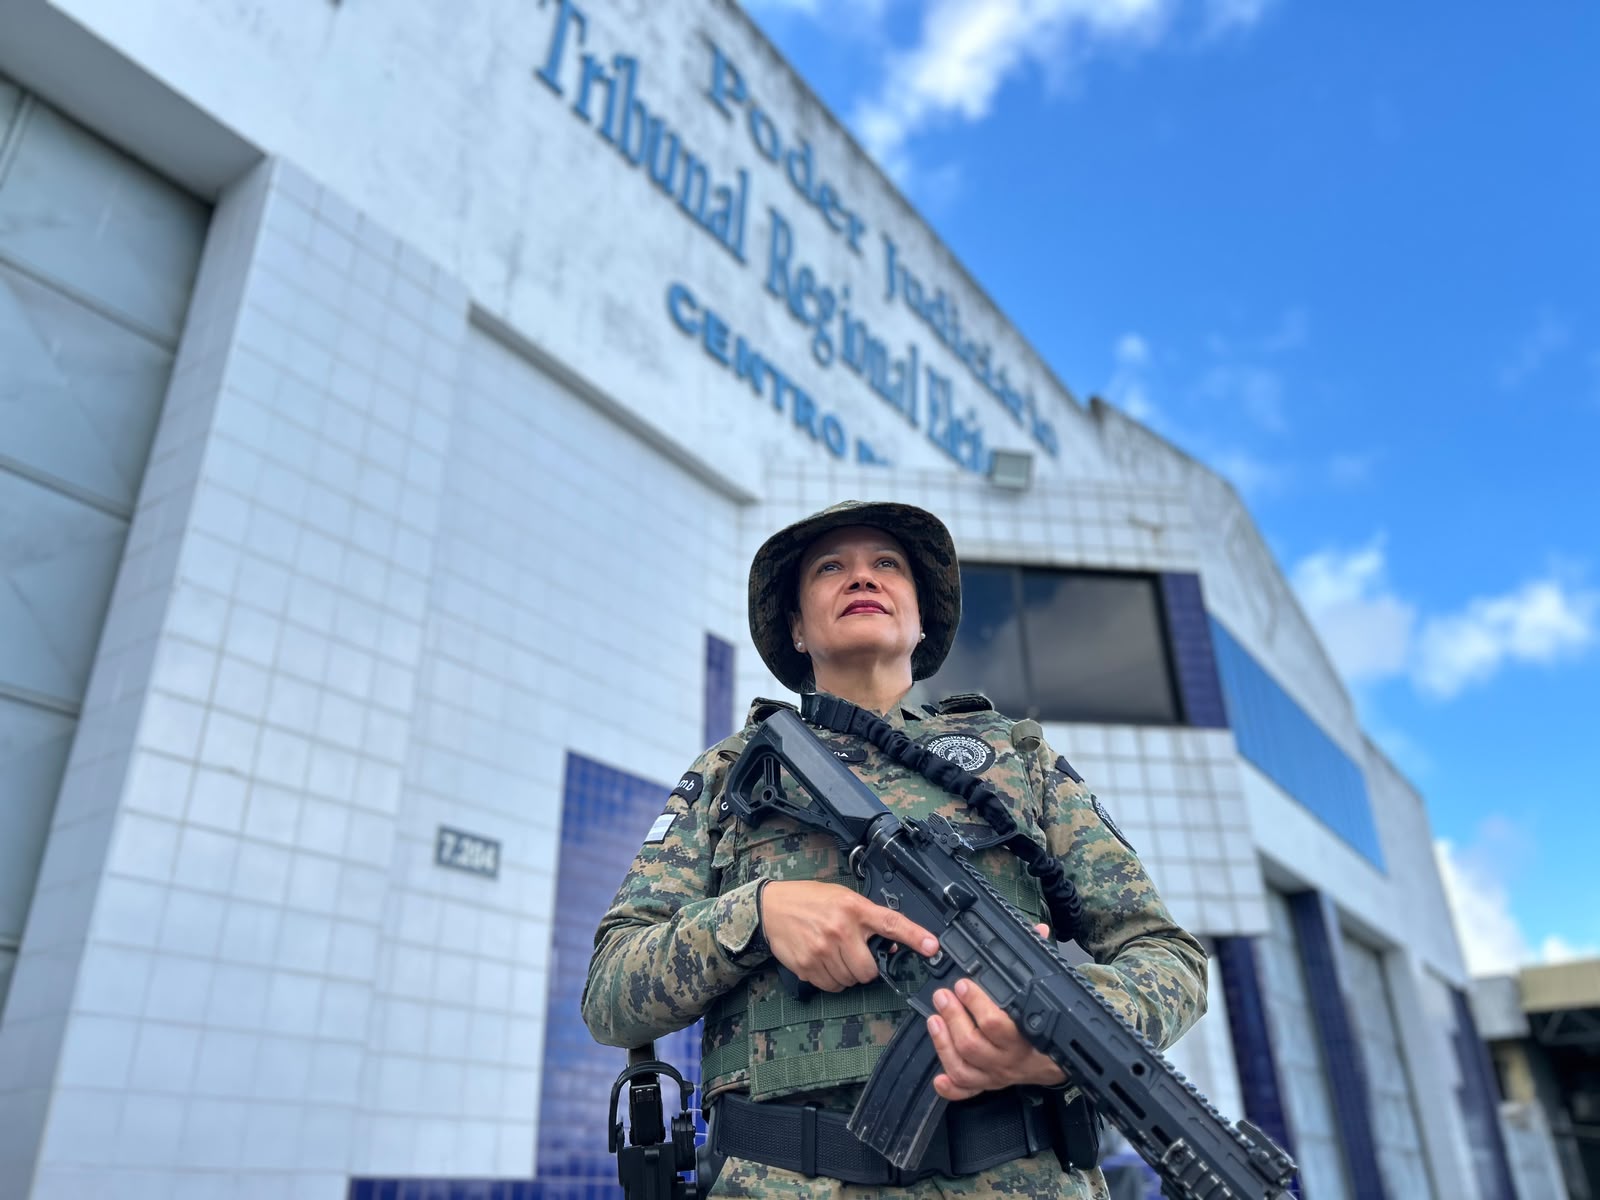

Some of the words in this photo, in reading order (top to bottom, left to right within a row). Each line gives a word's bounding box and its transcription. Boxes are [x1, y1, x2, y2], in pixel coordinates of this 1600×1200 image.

[533, 0, 750, 267] Tribunal
[764, 203, 919, 430] Regional
[699, 31, 867, 257] Poder
[666, 281, 847, 459] CENTRO
